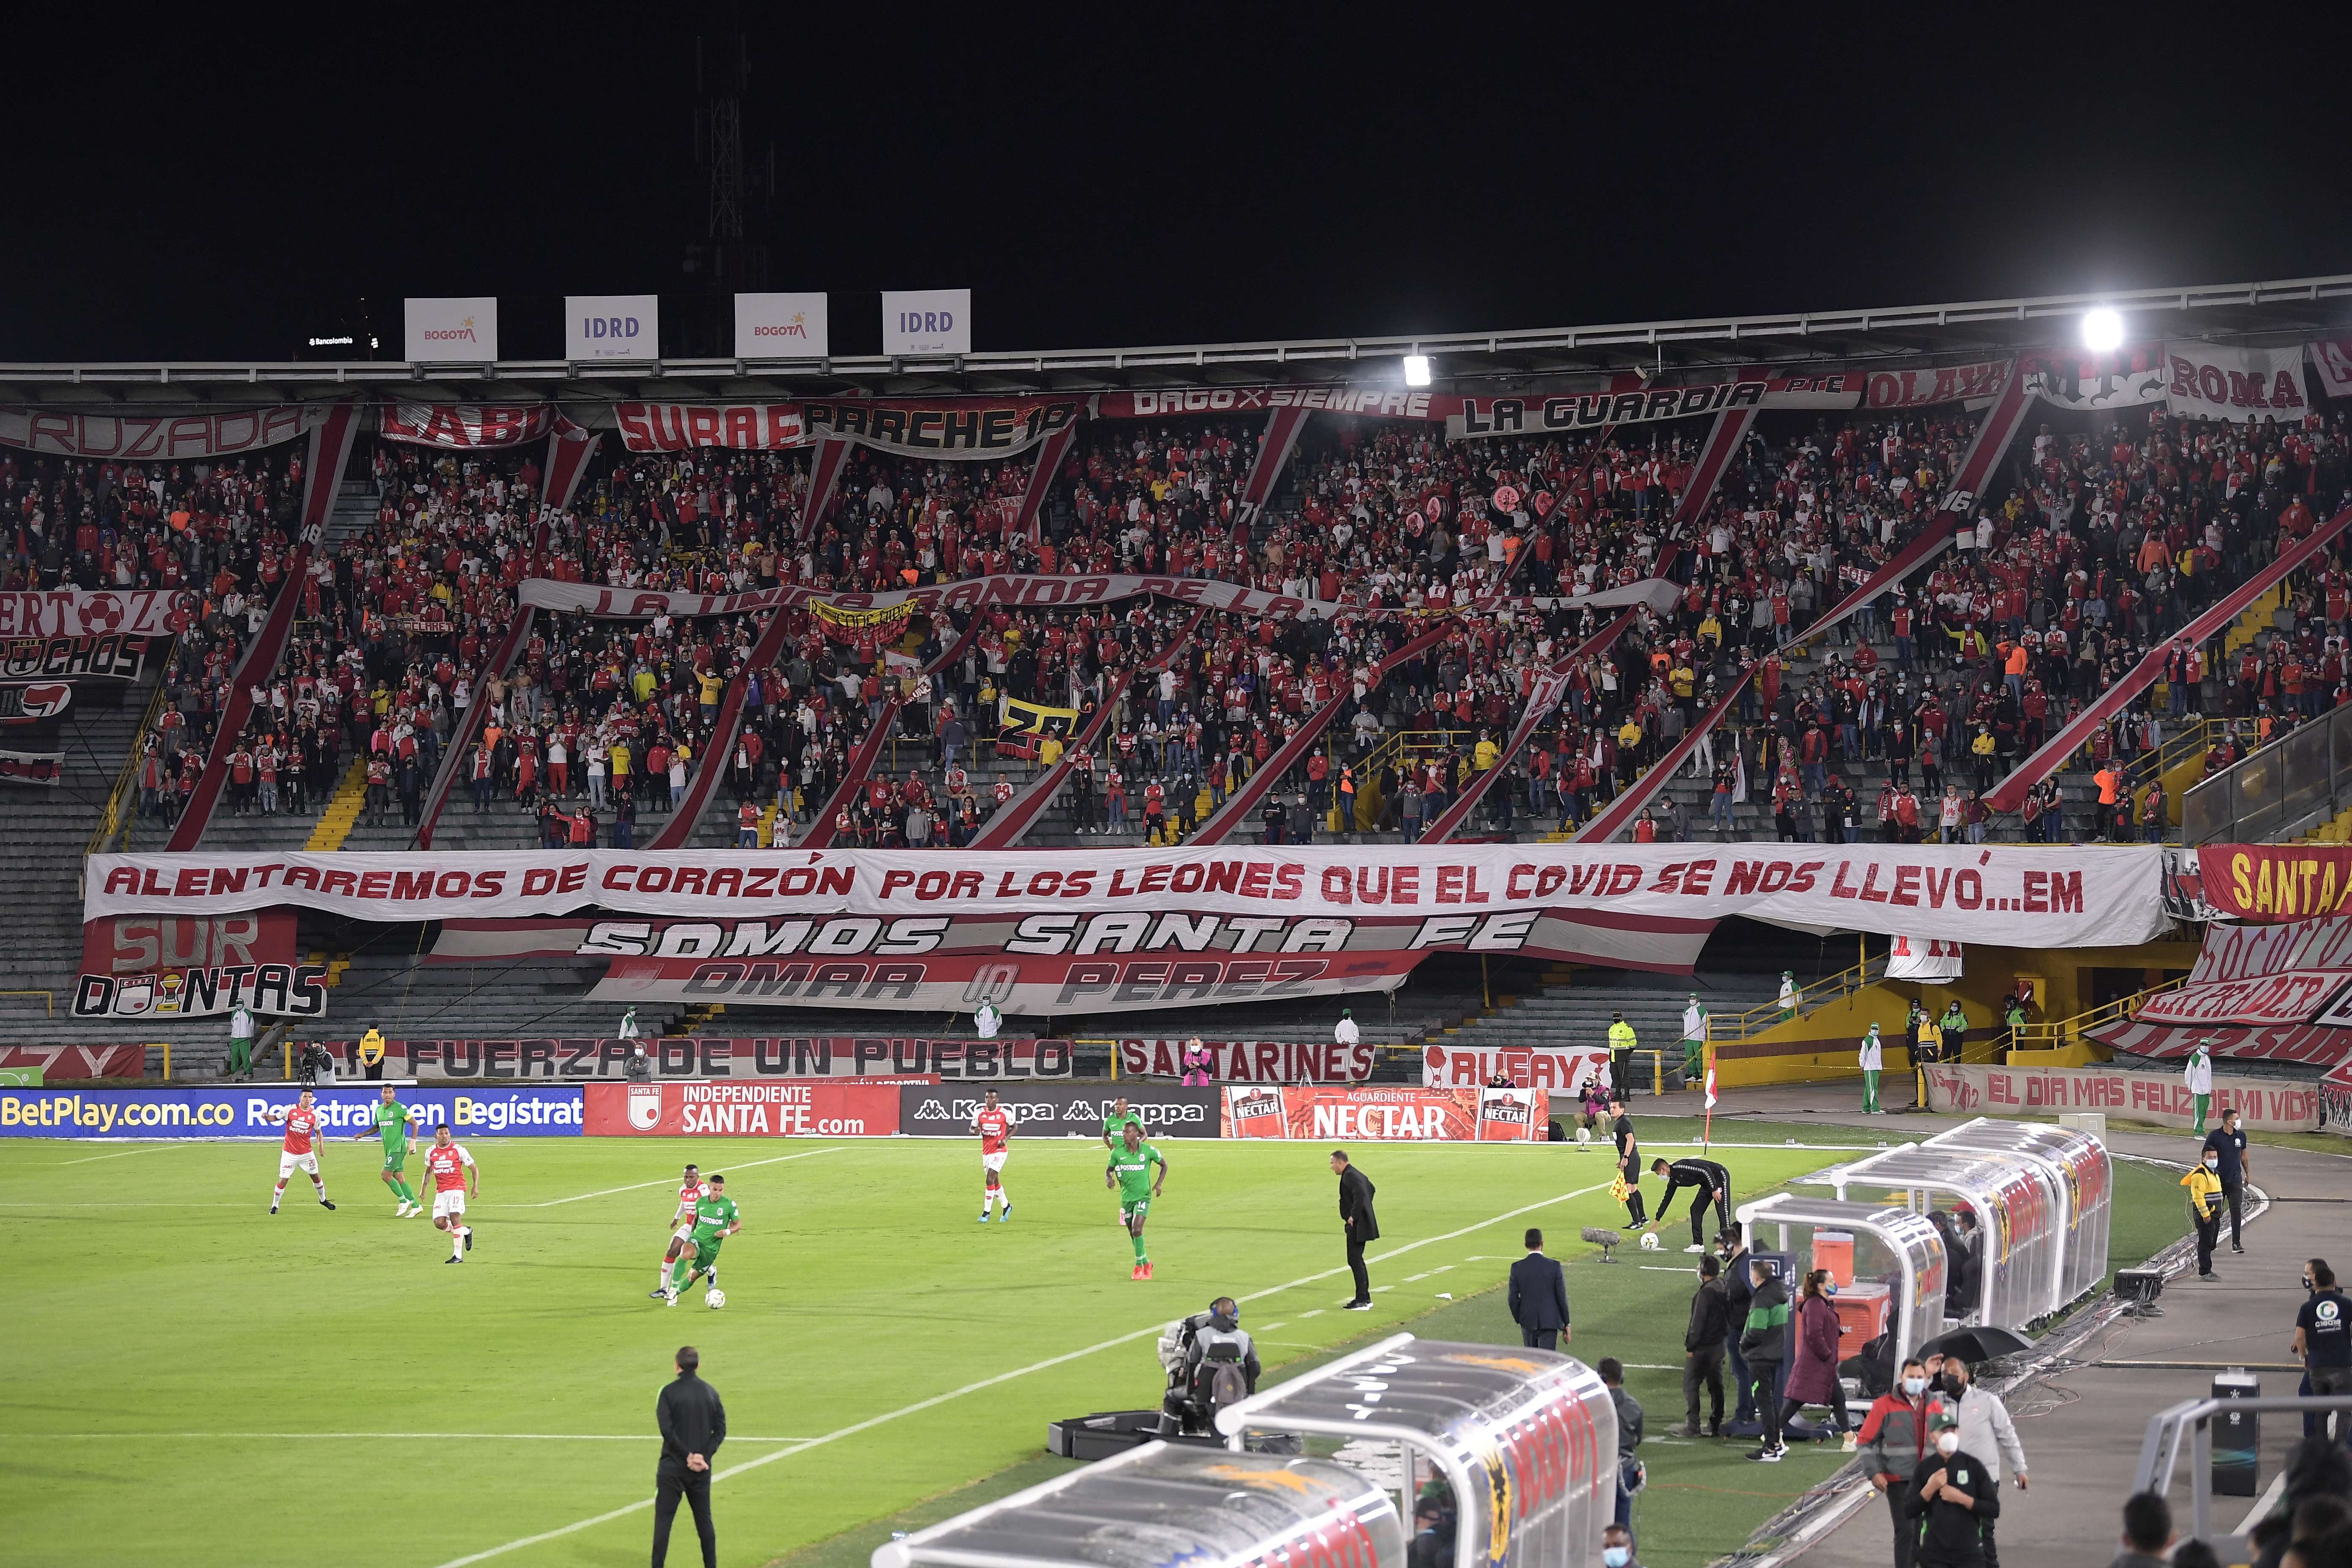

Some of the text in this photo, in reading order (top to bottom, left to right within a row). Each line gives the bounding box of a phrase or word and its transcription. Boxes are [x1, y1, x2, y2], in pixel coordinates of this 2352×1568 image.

[584, 317, 639, 338] IDRD
[901, 312, 953, 333] IDRD
[316, 336, 352, 345] Bancolombia
[1784, 375, 1846, 395] PTE
[2170, 354, 2305, 408] ROMA
[1133, 389, 1236, 415] DAGO
[1267, 388, 1432, 417] SIEMPRE
[1463, 381, 1768, 435] LA GUARDIA
[804, 403, 1016, 449] PARCHE
[593, 590, 670, 615] LA
[103, 863, 507, 900] ALENTAREMOS
[520, 862, 590, 897] DE
[602, 851, 855, 898] CORAZÓN
[878, 870, 985, 901] POR
[994, 870, 1097, 898] LOS
[1107, 861, 1305, 900] LEONES
[1320, 865, 1419, 904] QUE
[1435, 865, 1490, 904] EL
[1505, 863, 1644, 900] COVID
[1646, 859, 1717, 896] SE
[1723, 860, 1825, 896] NOS
[2232, 852, 2335, 915] SANTA
[112, 914, 258, 972] SUR
[576, 908, 1545, 959] SOMOS SANTA FE
[681, 959, 1330, 1006] OMAR 10 PEREZ
[406, 1039, 635, 1079] FUERZA
[657, 1038, 732, 1079] DE
[753, 1038, 833, 1077] UN
[854, 1038, 1072, 1080] PUEBLO
[630, 1088, 650, 1096] SANTA
[683, 1086, 811, 1103] INDEPENDIENTE
[1346, 1092, 1416, 1102] AGUARDIENTE
[1987, 1073, 2020, 1105] EL
[2027, 1067, 2067, 1106] DÍA
[2132, 1080, 2193, 1116] FELIZ
[2234, 1088, 2262, 1120] MI
[2269, 1091, 2319, 1121] VIDA
[1, 1095, 234, 1132] BetPlay.com.co
[454, 1094, 583, 1130] Begístrat
[682, 1105, 770, 1132] SANTA
[1236, 1102, 1279, 1119] NECTAR
[1313, 1104, 1448, 1138] NECTAR
[1484, 1108, 1527, 1123] NECTAR
[453, 1196, 459, 1204] 17
[1138, 1201, 1146, 1209] 14
